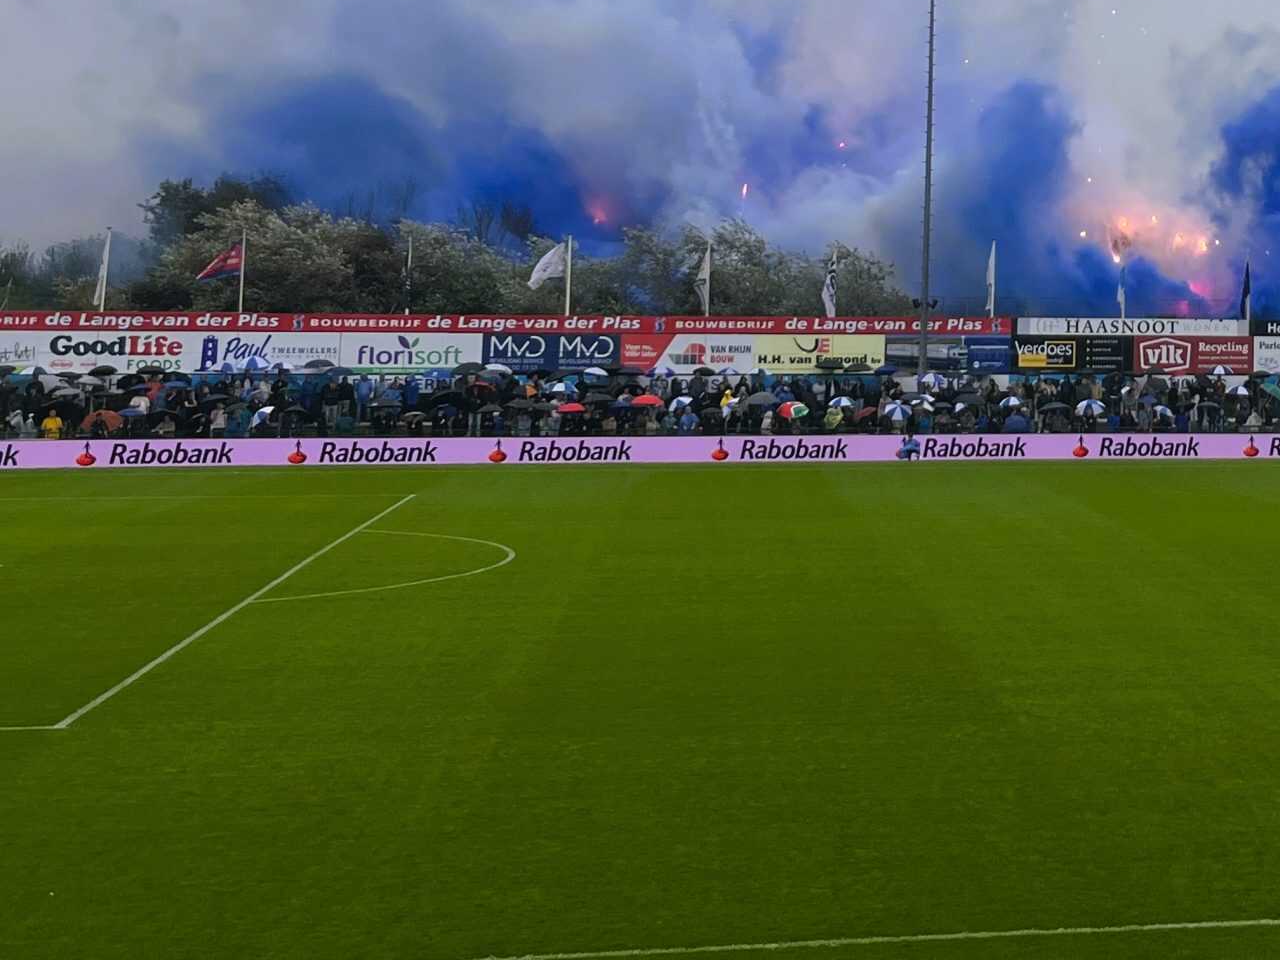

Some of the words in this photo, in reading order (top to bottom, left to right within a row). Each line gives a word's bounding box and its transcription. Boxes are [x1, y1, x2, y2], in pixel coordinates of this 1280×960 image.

[45, 312, 72, 326] de
[195, 313, 233, 327] der
[237, 313, 280, 327] Plas
[310, 318, 422, 328] BOUWBEDRIJF
[427, 315, 452, 328] de
[563, 316, 598, 329] der
[602, 316, 641, 329] Plas
[674, 320, 775, 329] BOUWBEDRIJF
[784, 317, 808, 330] de
[947, 318, 983, 330] Plas
[1065, 319, 1179, 334] HAASNOOT
[49, 335, 184, 356] GoodLife
[223, 334, 273, 363] Paul
[271, 346, 337, 355] TWEEWIELERS
[710, 344, 727, 354] VAN
[728, 344, 752, 354] RHIJN
[1014, 339, 1073, 356] verdoes
[1145, 343, 1185, 364] vlk
[1197, 341, 1249, 354] Recycling
[357, 344, 463, 365] florisoft
[710, 355, 735, 364] BOUW
[758, 355, 785, 364] H.H.
[789, 356, 812, 365] van
[127, 358, 182, 371] FOODS
[109, 442, 234, 465] Rabobank
[320, 441, 437, 463] Rabobank
[519, 440, 632, 462] Rabobank
[740, 438, 847, 460] Rabobank
[922, 437, 1026, 458] Rabobank
[1099, 436, 1200, 457] Rabobank
